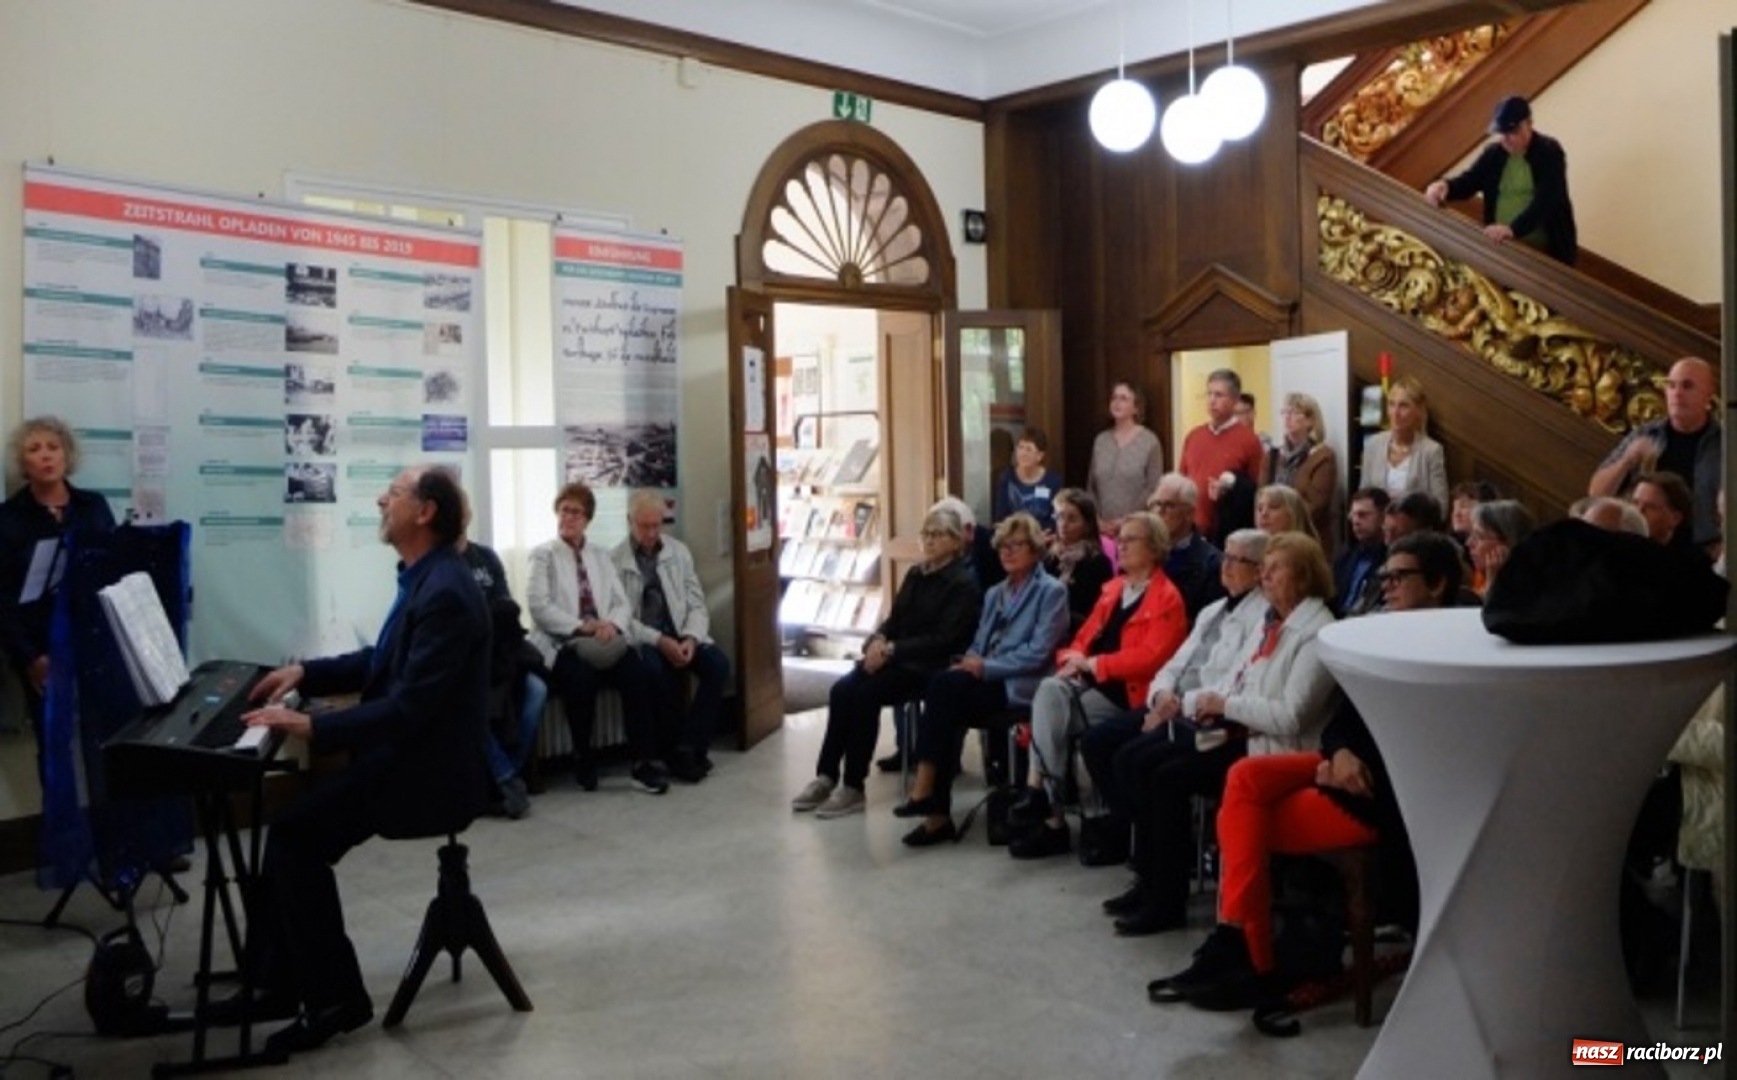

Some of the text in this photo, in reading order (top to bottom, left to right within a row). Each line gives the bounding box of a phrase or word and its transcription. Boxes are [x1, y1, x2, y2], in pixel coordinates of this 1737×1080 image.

[123, 202, 215, 229] ZEITSTRAHL
[218, 216, 286, 240] OPLADEN
[290, 226, 321, 243] VON
[325, 230, 355, 248] 1945
[359, 235, 380, 251] BIS
